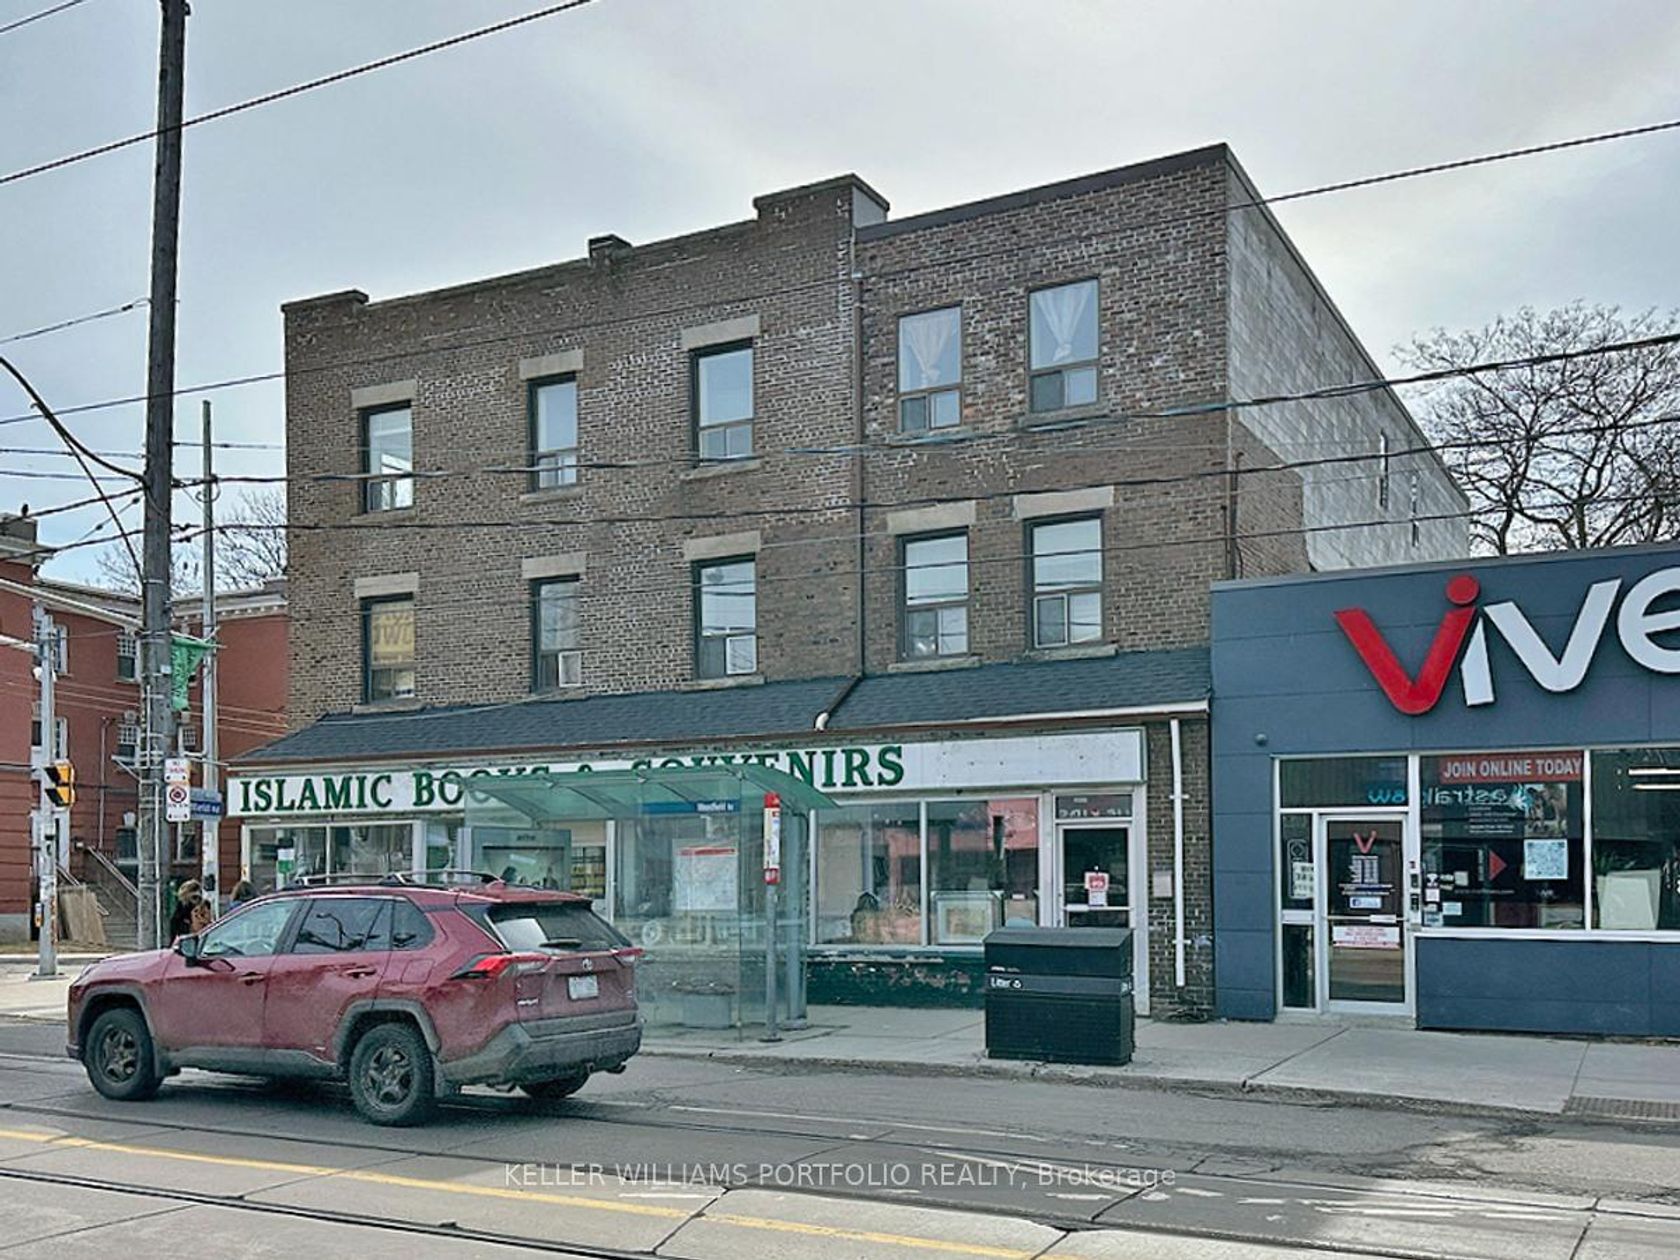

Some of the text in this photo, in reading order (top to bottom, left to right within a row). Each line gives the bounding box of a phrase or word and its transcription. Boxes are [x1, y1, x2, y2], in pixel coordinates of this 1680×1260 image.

[1443, 757, 1582, 778] JOIN ONLINE TODAY
[239, 774, 393, 812] ISLAMIC
